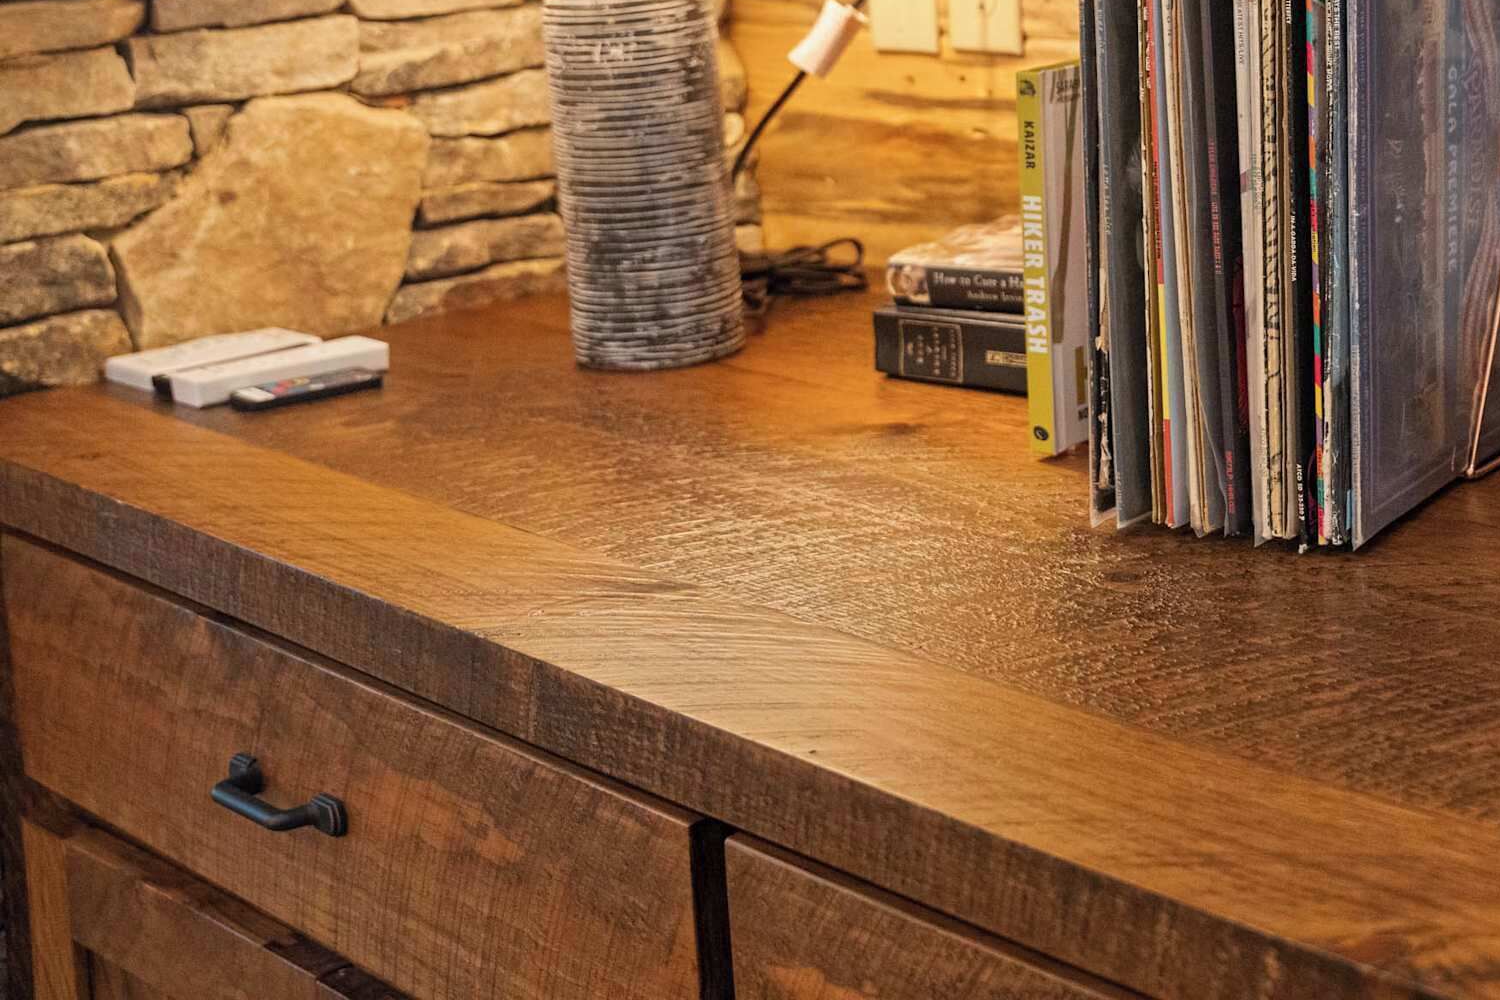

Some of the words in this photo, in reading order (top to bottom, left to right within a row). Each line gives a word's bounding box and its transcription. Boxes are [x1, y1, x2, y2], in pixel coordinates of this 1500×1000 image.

[1447, 65, 1459, 134] GALA
[1023, 120, 1037, 170] KAIZAR
[1022, 195, 1045, 268] HIKER
[1447, 143, 1460, 274] PREMIERE
[932, 271, 957, 285] How
[1026, 276, 1049, 355] TRASH
